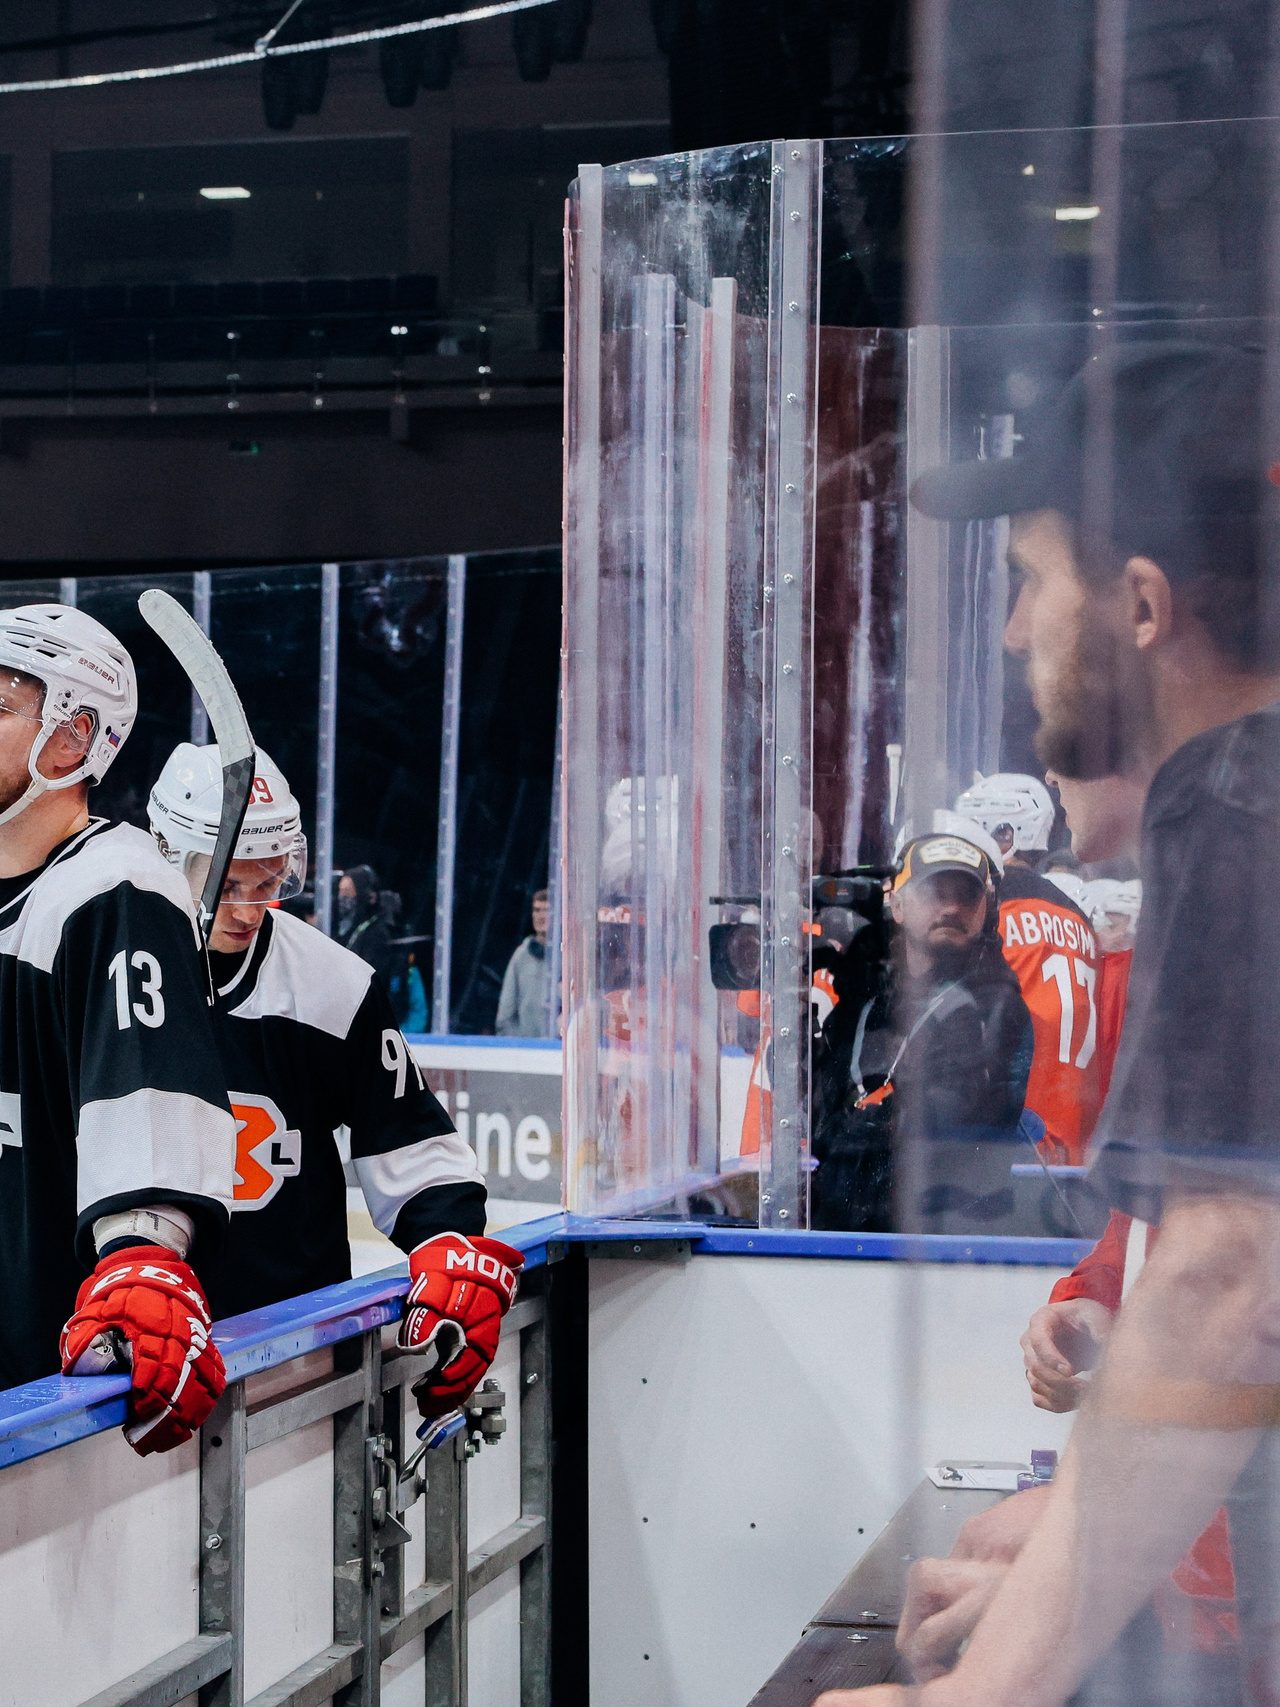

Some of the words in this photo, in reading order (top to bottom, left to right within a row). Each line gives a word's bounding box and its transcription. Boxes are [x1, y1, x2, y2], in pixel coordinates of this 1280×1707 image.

[77, 656, 115, 684] BAUER
[249, 776, 274, 805] 9
[241, 824, 283, 835] BAUER
[108, 949, 166, 1031] 13
[1041, 953, 1097, 1069] 17
